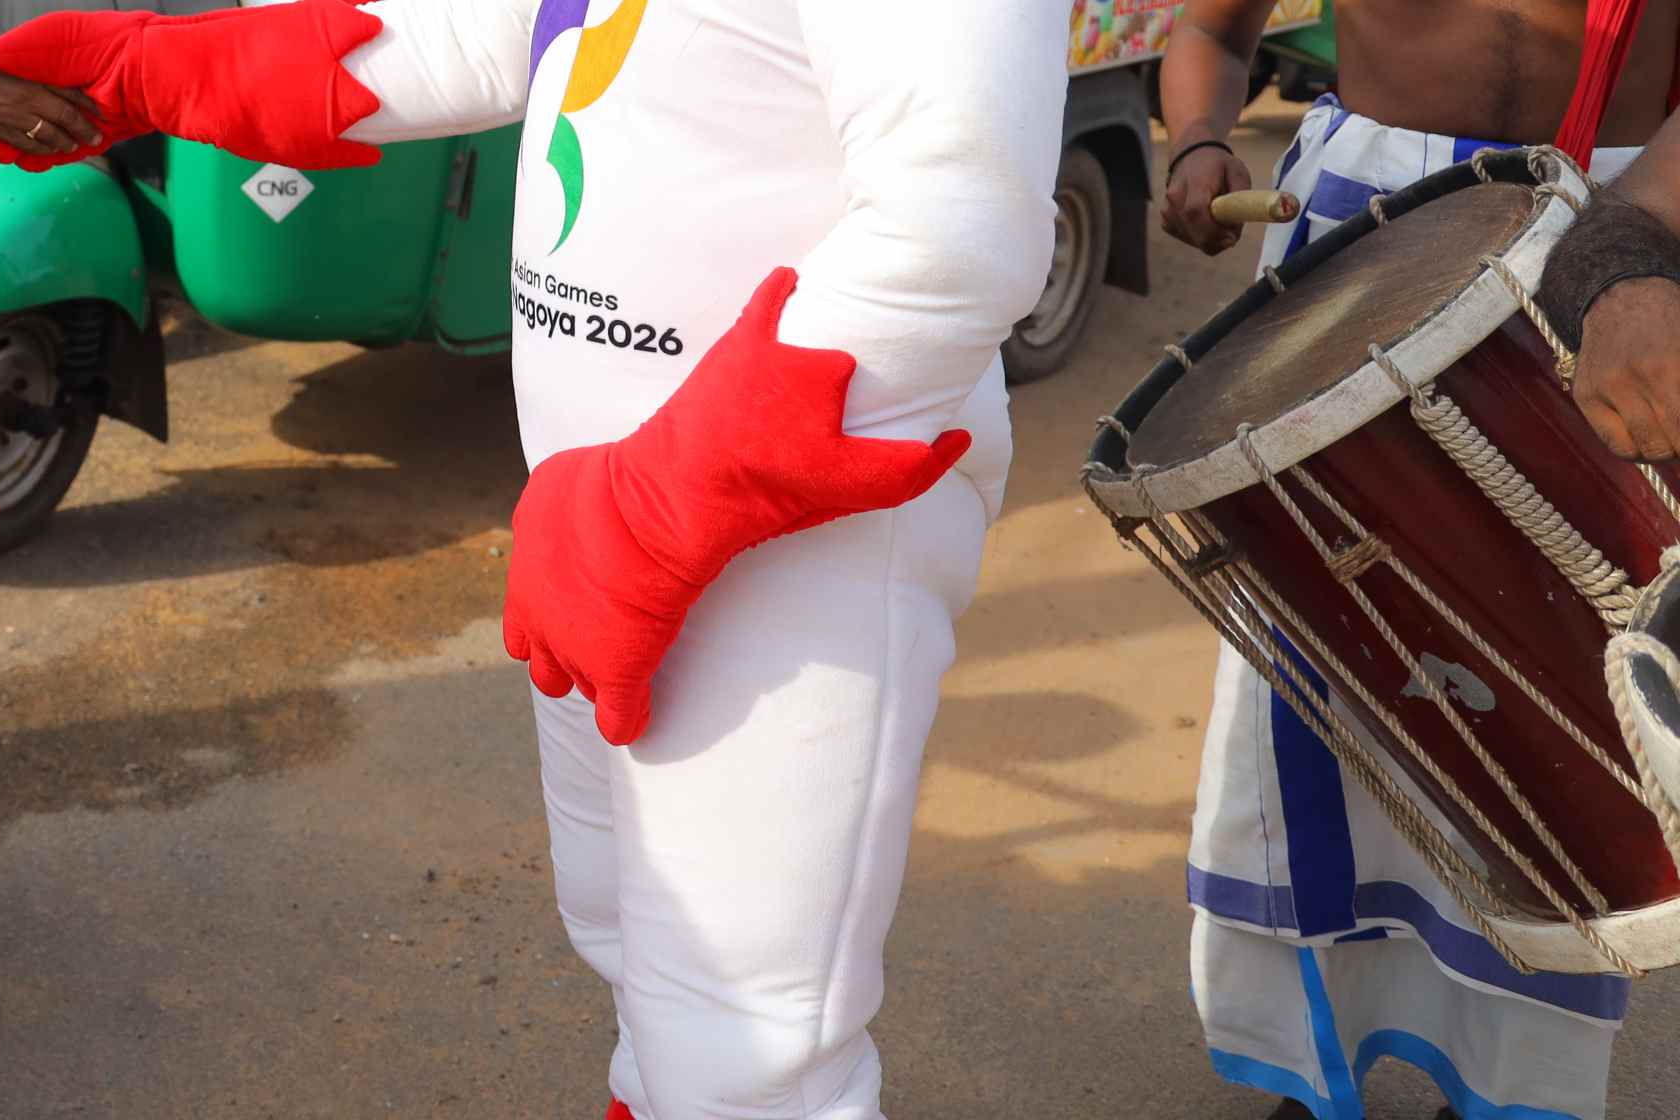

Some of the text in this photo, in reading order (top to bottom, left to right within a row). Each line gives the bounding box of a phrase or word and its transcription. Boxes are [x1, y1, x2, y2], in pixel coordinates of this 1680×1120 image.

[257, 180, 298, 196] CNG
[514, 258, 541, 289] Asian
[545, 275, 618, 311] Games
[513, 283, 684, 356] Nagoya 2026
